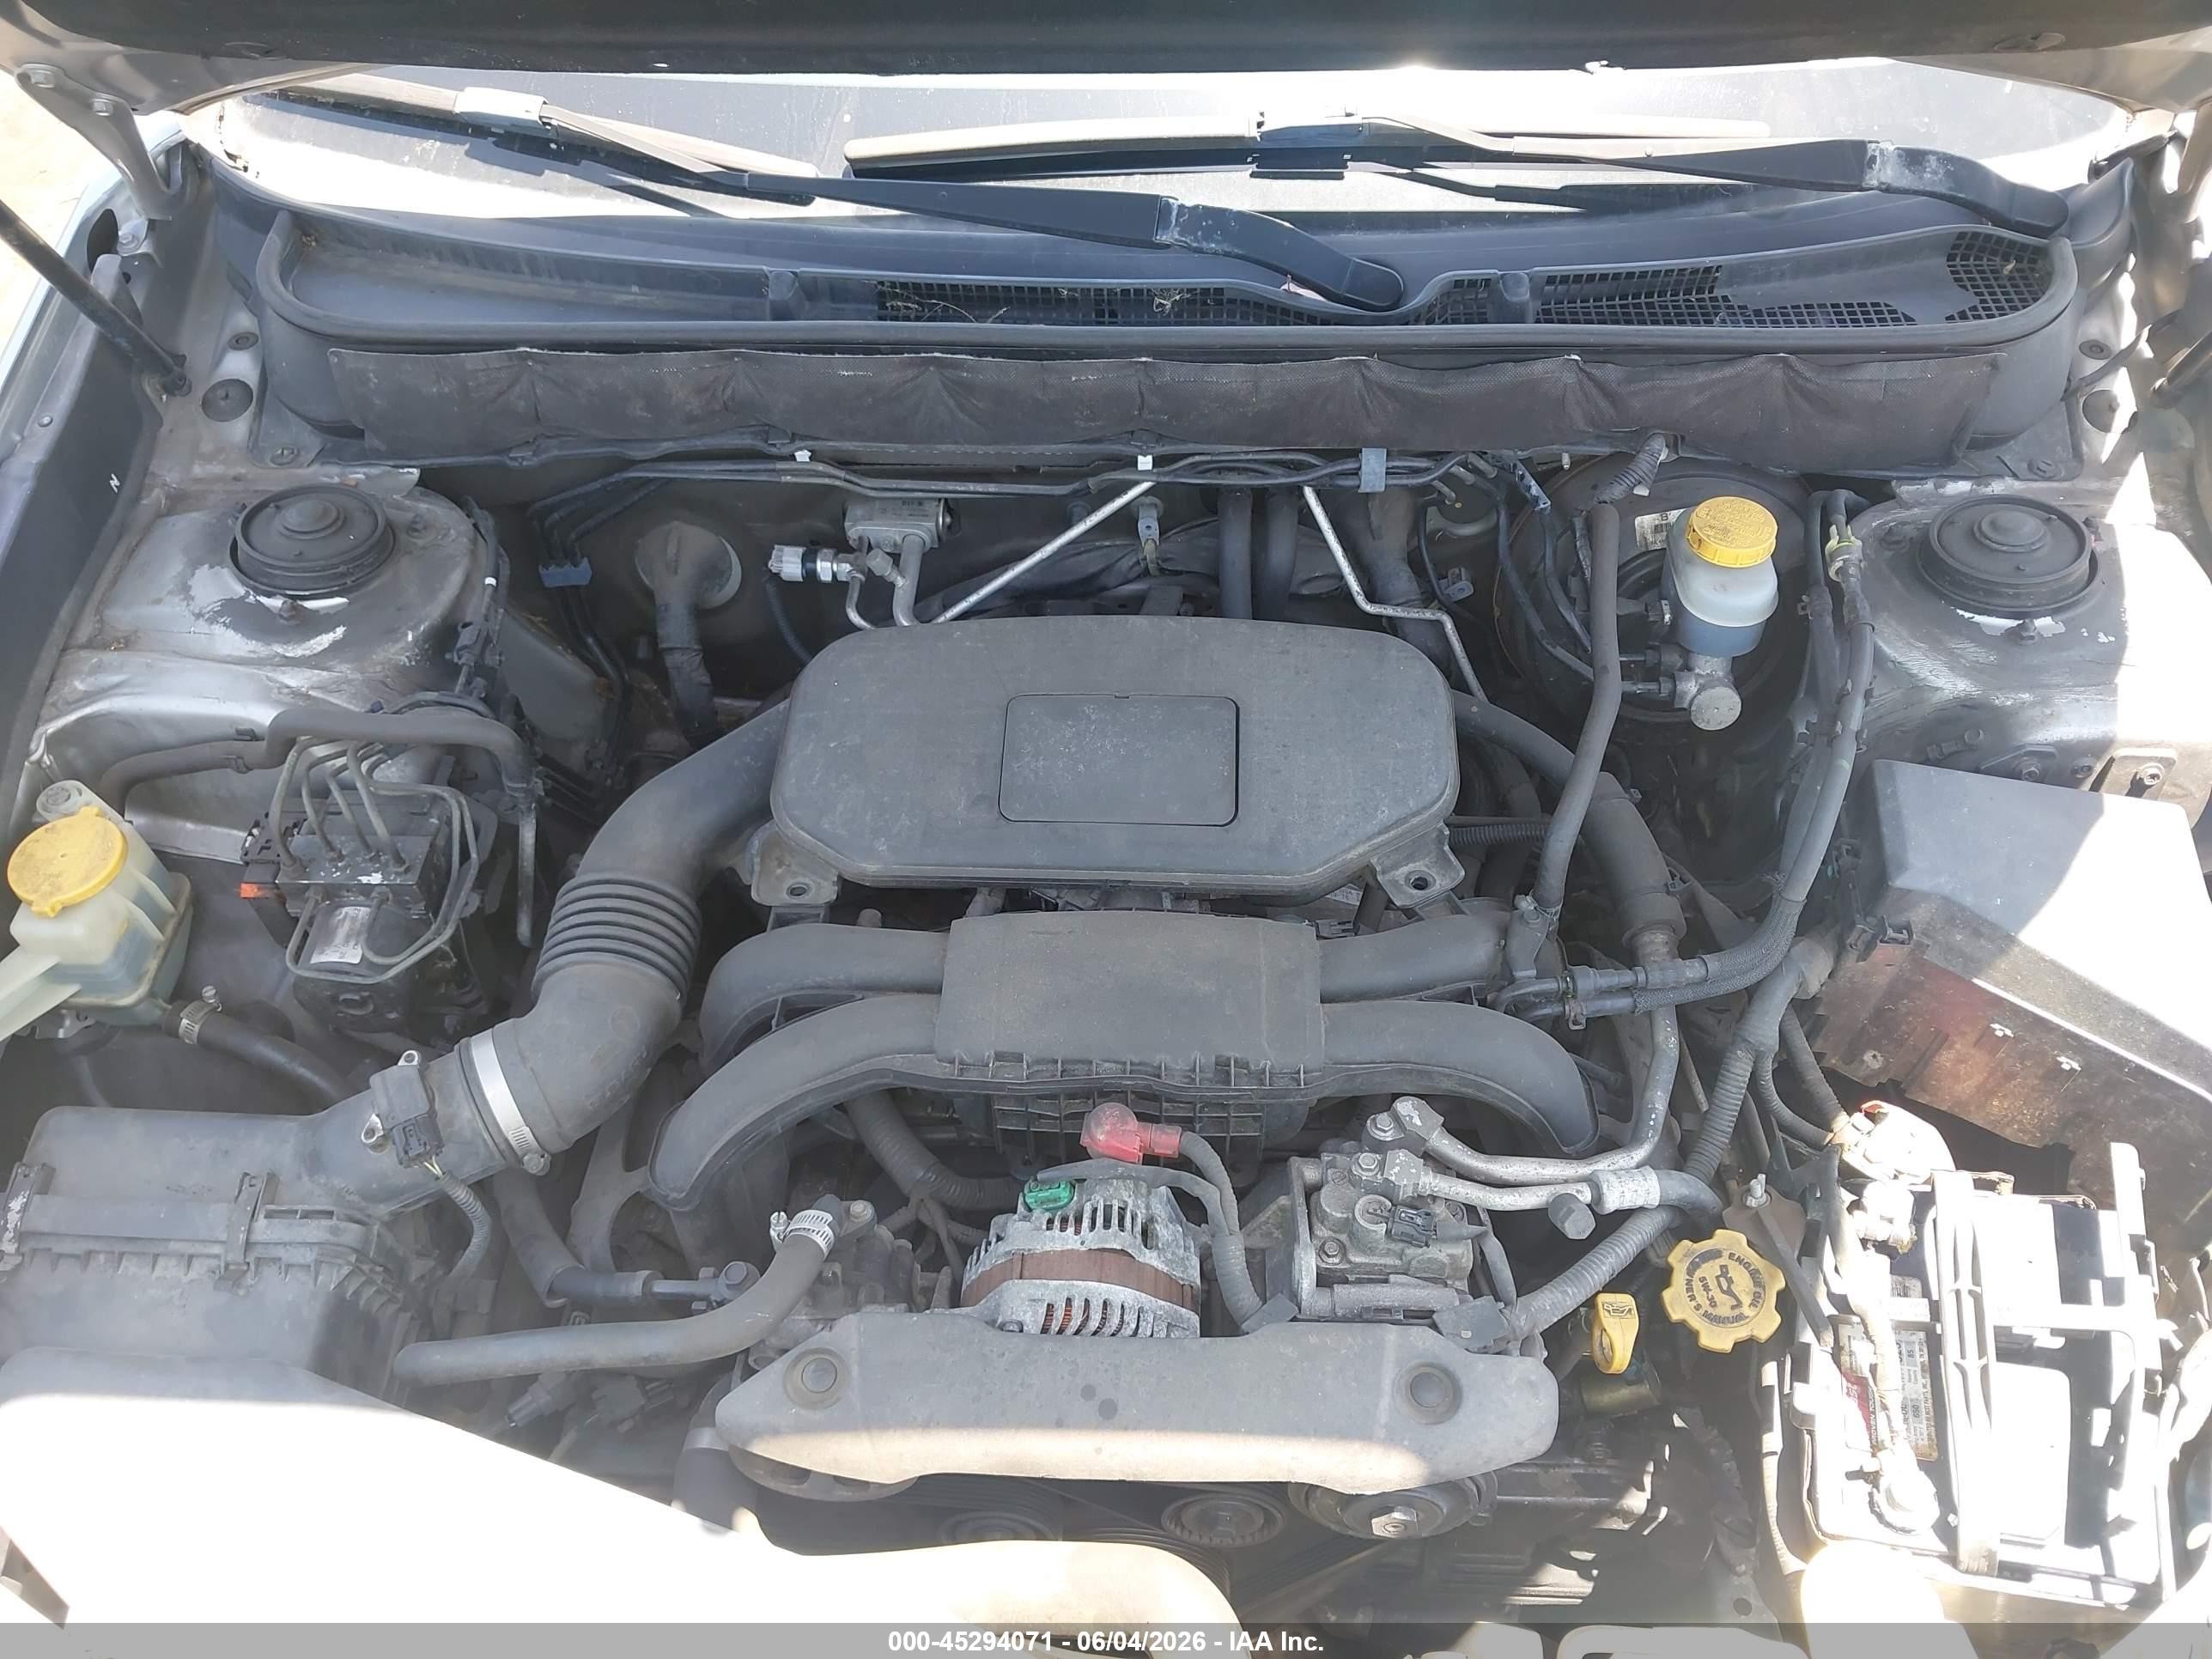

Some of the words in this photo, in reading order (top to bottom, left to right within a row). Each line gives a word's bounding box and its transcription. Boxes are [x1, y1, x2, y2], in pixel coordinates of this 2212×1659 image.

[1698, 1276, 1718, 1309] 5W-30
[1728, 1252, 1764, 1289] ENGINE
[1748, 1290, 1763, 1310] OIL
[1702, 1310, 1750, 1325] MANUAL
[1911, 1404, 1920, 1419] 650
